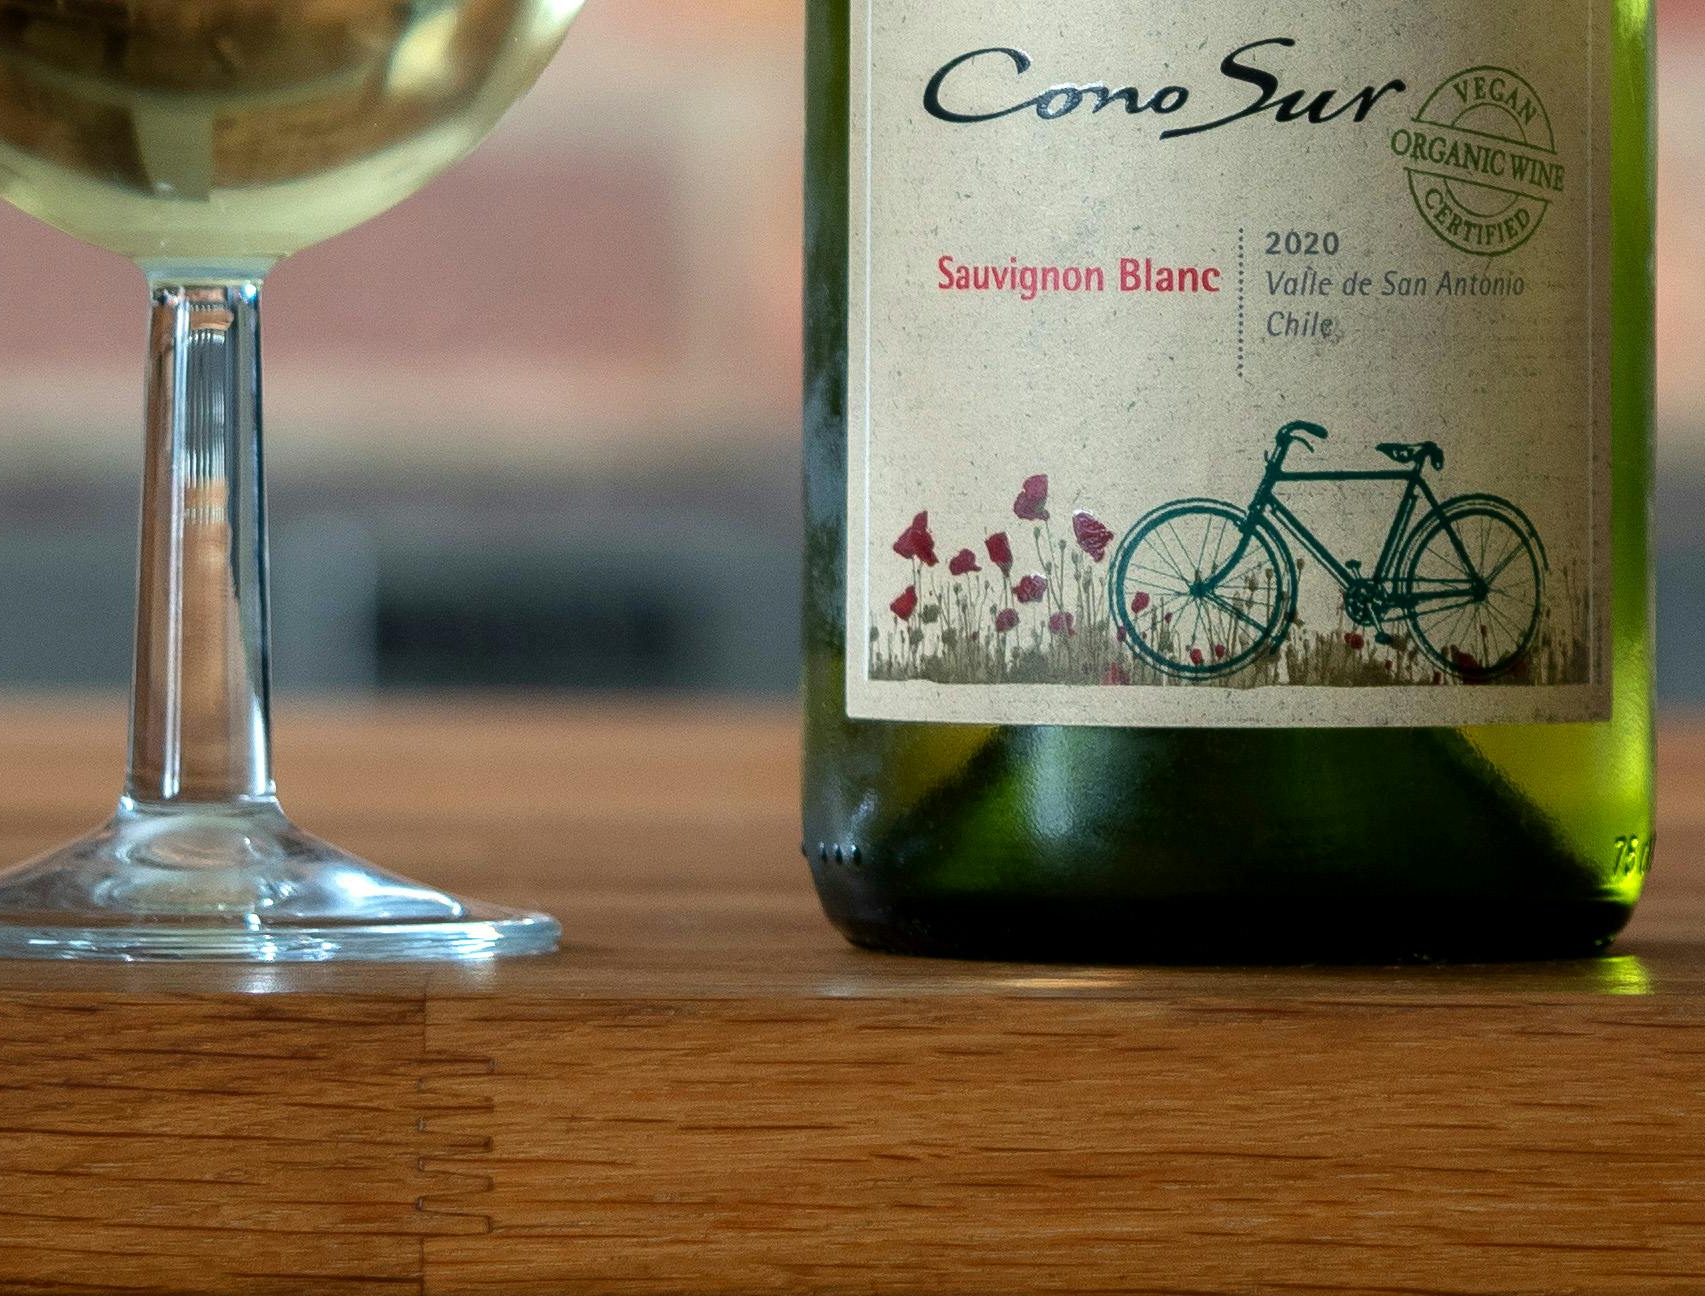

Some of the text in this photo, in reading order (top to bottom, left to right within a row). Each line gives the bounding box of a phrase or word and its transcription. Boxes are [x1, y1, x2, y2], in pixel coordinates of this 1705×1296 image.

[923, 36, 1407, 141] Cono Sur
[1452, 76, 1538, 126] VEGAN
[1390, 128, 1566, 193] ORGANIC WINE
[1424, 187, 1531, 247] CERTIFIED
[1264, 230, 1340, 256] 2020
[937, 254, 1222, 301] Sauvignon Blanc
[1265, 267, 1526, 296] Valle de San Antonio
[1266, 310, 1335, 338] Chile
